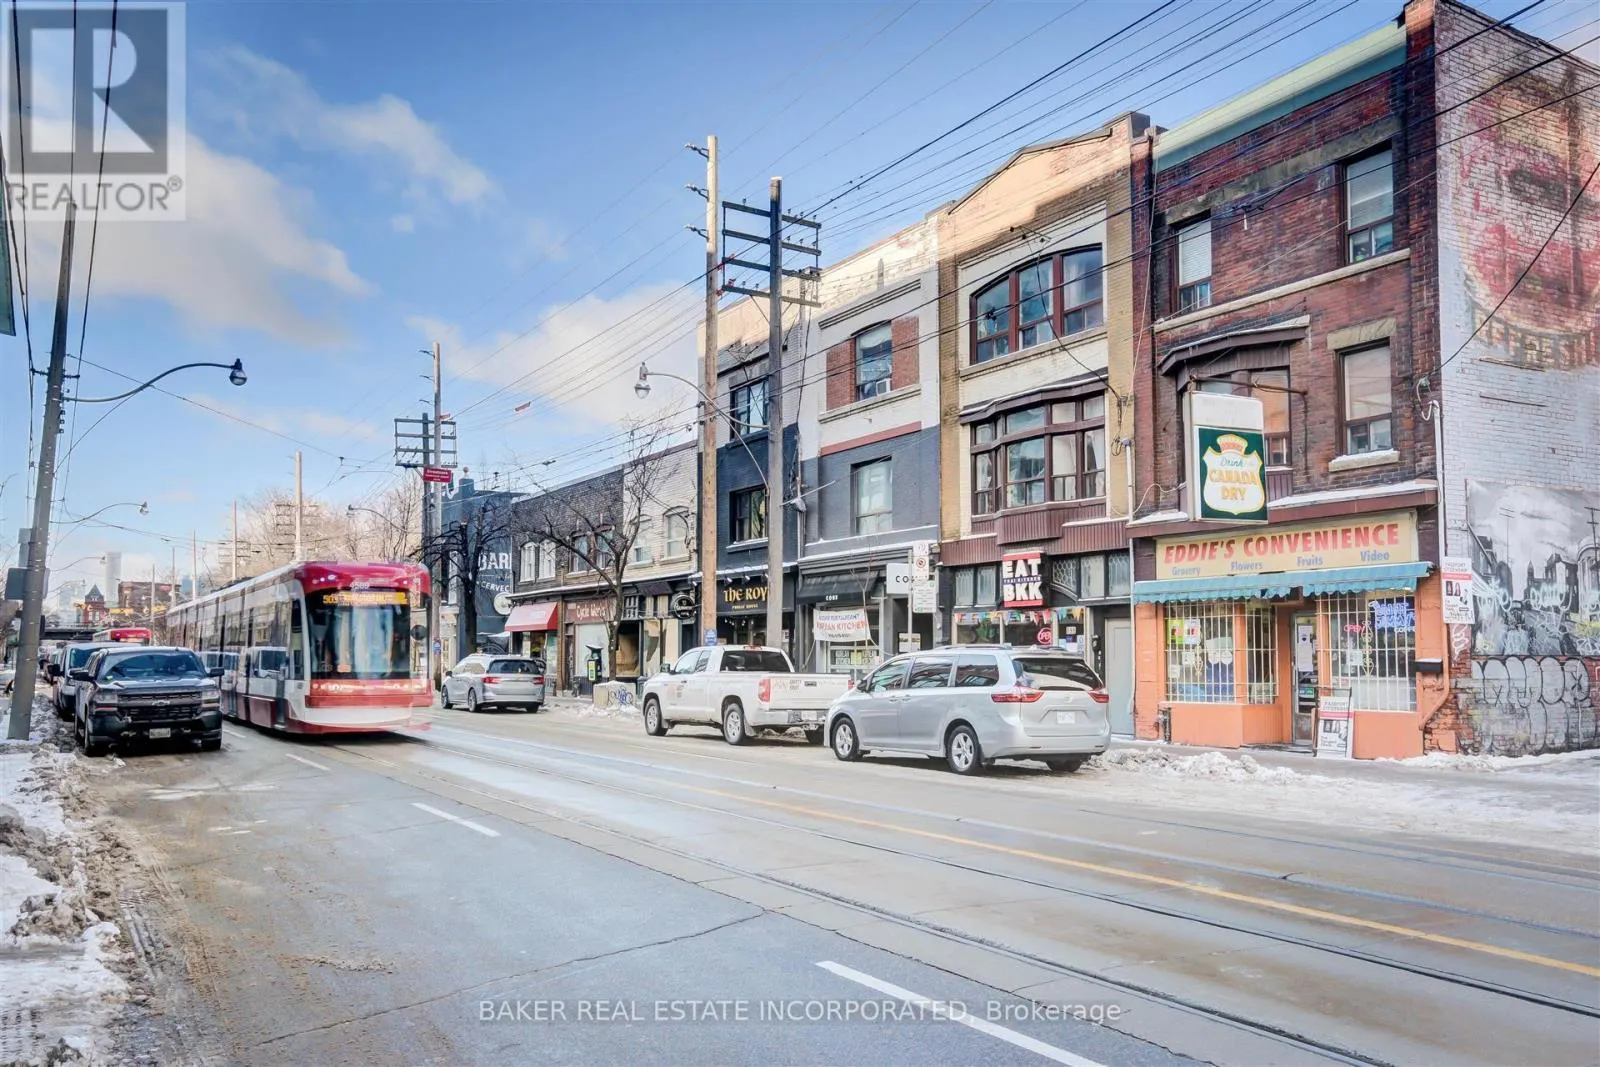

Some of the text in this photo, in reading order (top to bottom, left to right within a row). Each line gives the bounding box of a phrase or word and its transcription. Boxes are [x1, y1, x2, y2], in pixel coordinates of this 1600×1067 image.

[1210, 469, 1260, 484] CANADA
[1221, 486, 1246, 500] DRY
[1164, 523, 1399, 564] EDDIE'S CONVENIENCE
[1002, 558, 1041, 578] EAT
[1172, 549, 1390, 576] Grocery Flowers Fruits Video
[1003, 582, 1043, 601] BKK
[1343, 624, 1365, 632] OPEN
